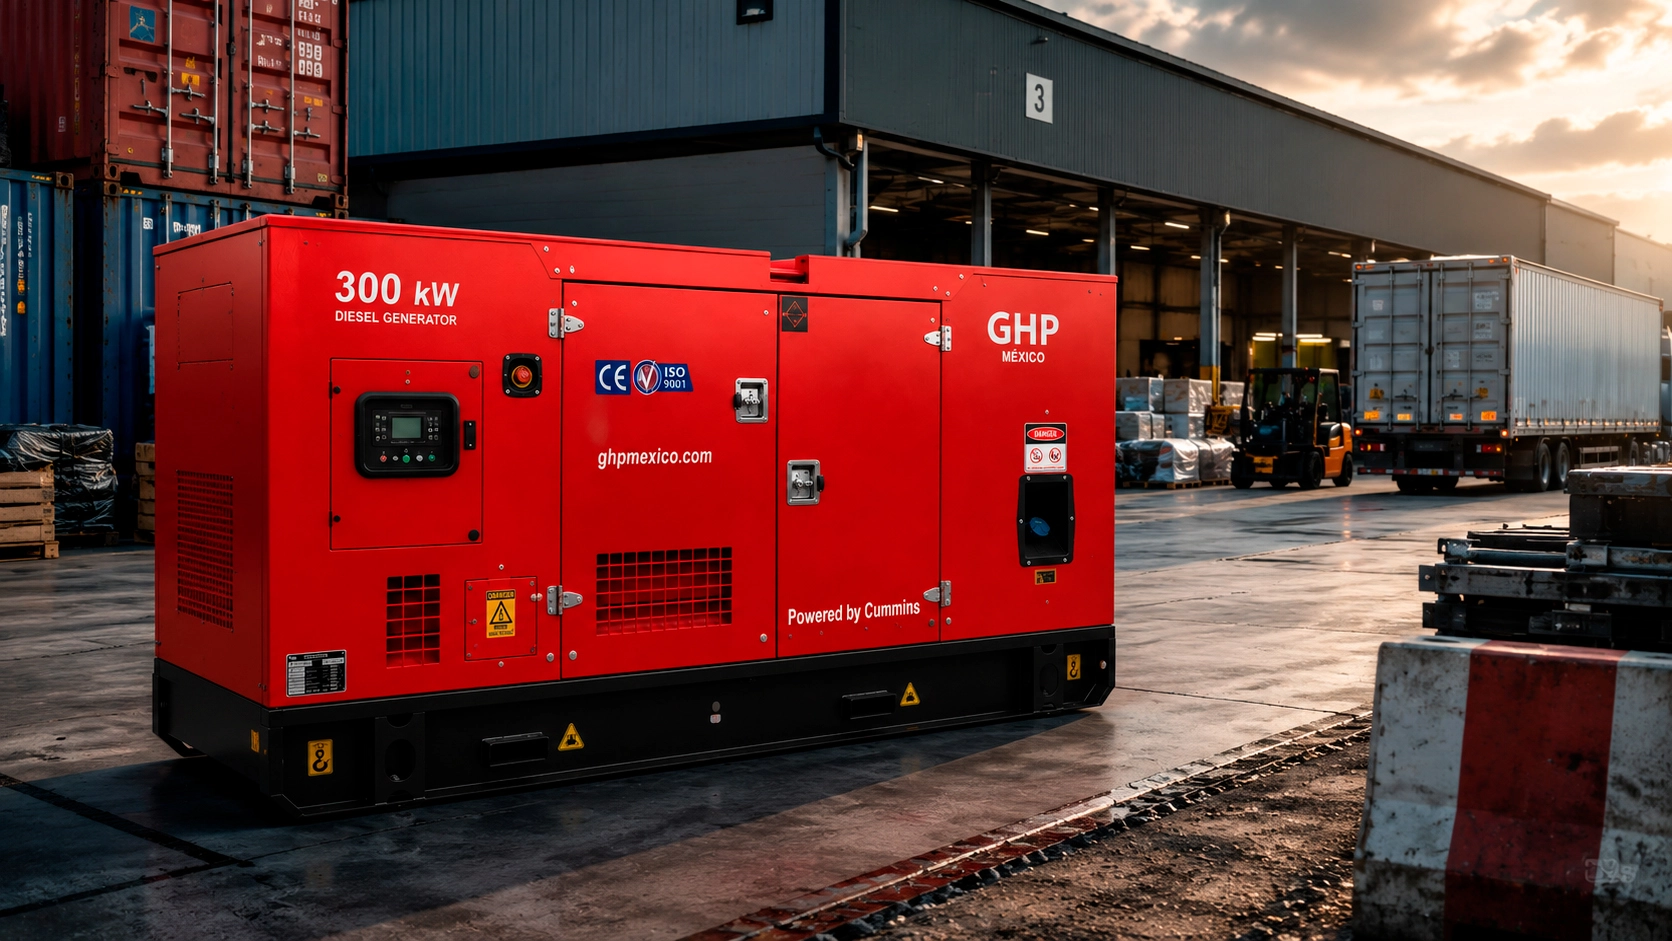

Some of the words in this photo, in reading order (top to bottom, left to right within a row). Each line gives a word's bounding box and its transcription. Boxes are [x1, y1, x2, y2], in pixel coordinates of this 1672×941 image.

[1034, 83, 1045, 113] 3
[335, 270, 401, 305] 300
[414, 280, 460, 307] kW
[335, 310, 379, 323] DIESEL
[383, 312, 457, 326] GENERATOR
[987, 311, 1060, 346] GHP
[1002, 348, 1046, 363] MÉXICO
[599, 364, 627, 391] CE
[663, 379, 686, 389] 9001
[664, 366, 686, 378] ISO
[597, 447, 713, 470] ghpmexico.com
[788, 604, 843, 626] Powered
[846, 603, 861, 624] by
[864, 599, 920, 619] Cummins
